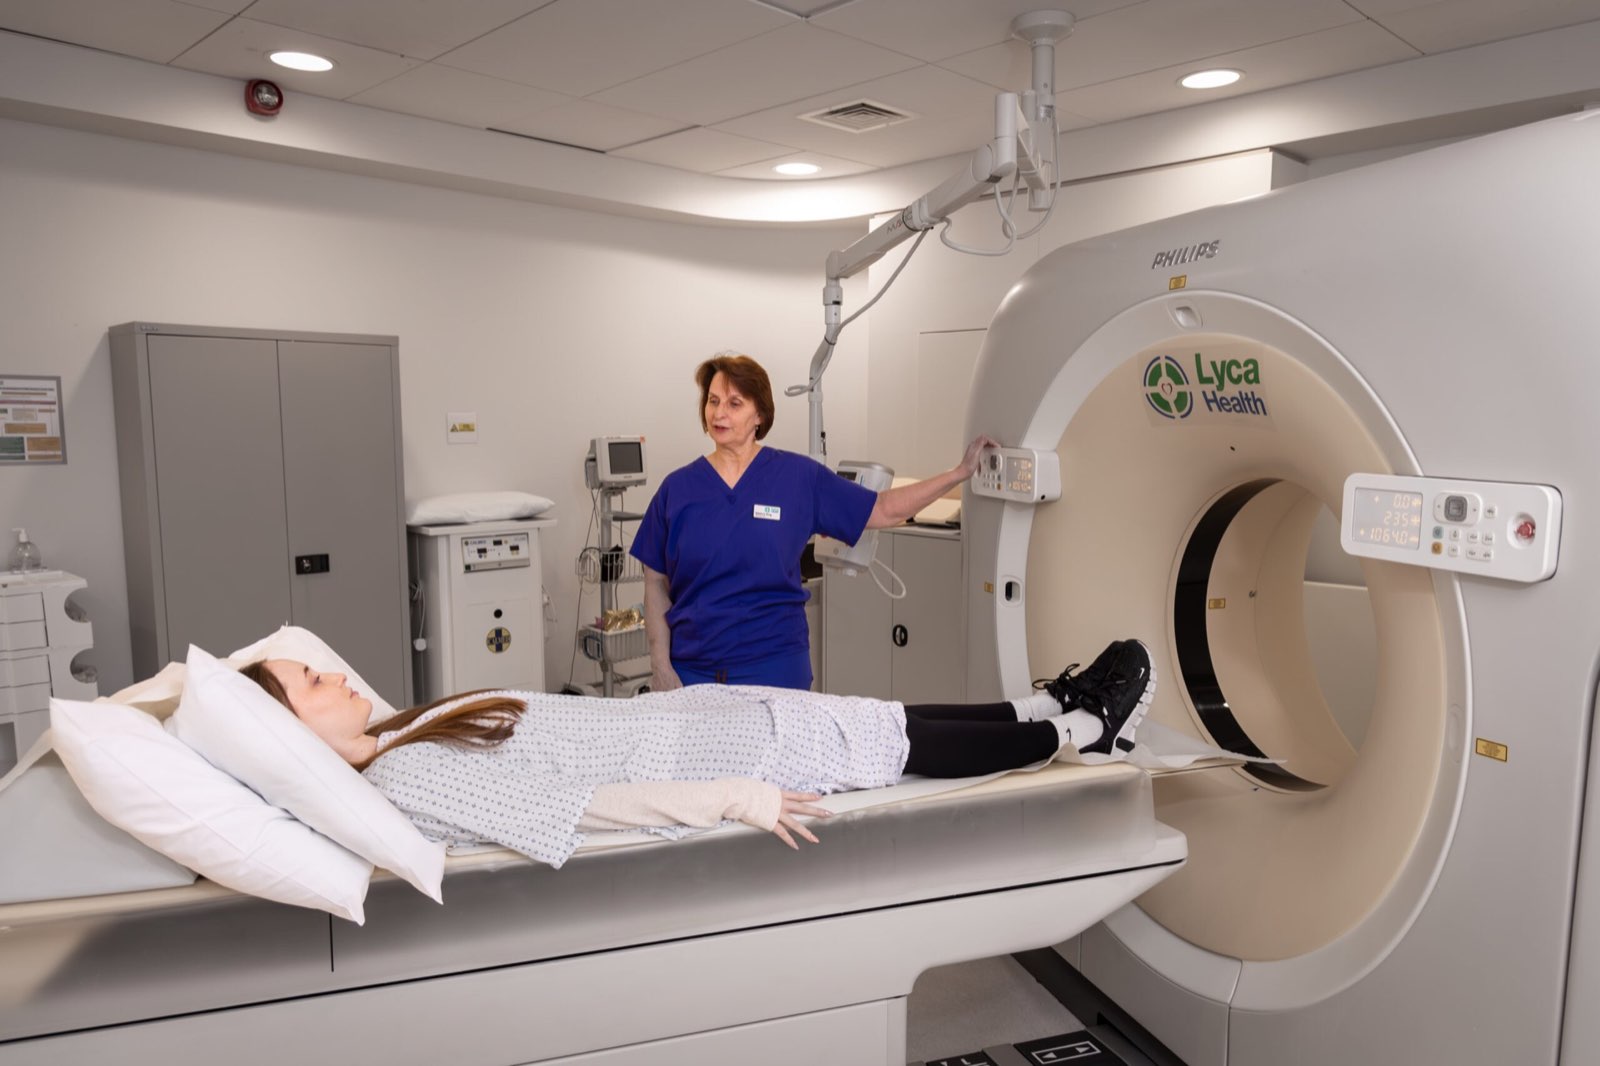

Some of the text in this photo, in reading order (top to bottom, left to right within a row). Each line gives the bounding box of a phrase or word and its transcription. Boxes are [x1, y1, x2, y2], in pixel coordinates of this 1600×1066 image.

[1152, 239, 1219, 269] PHILIPS
[1195, 353, 1260, 391] Lyca
[1202, 391, 1267, 416] Health
